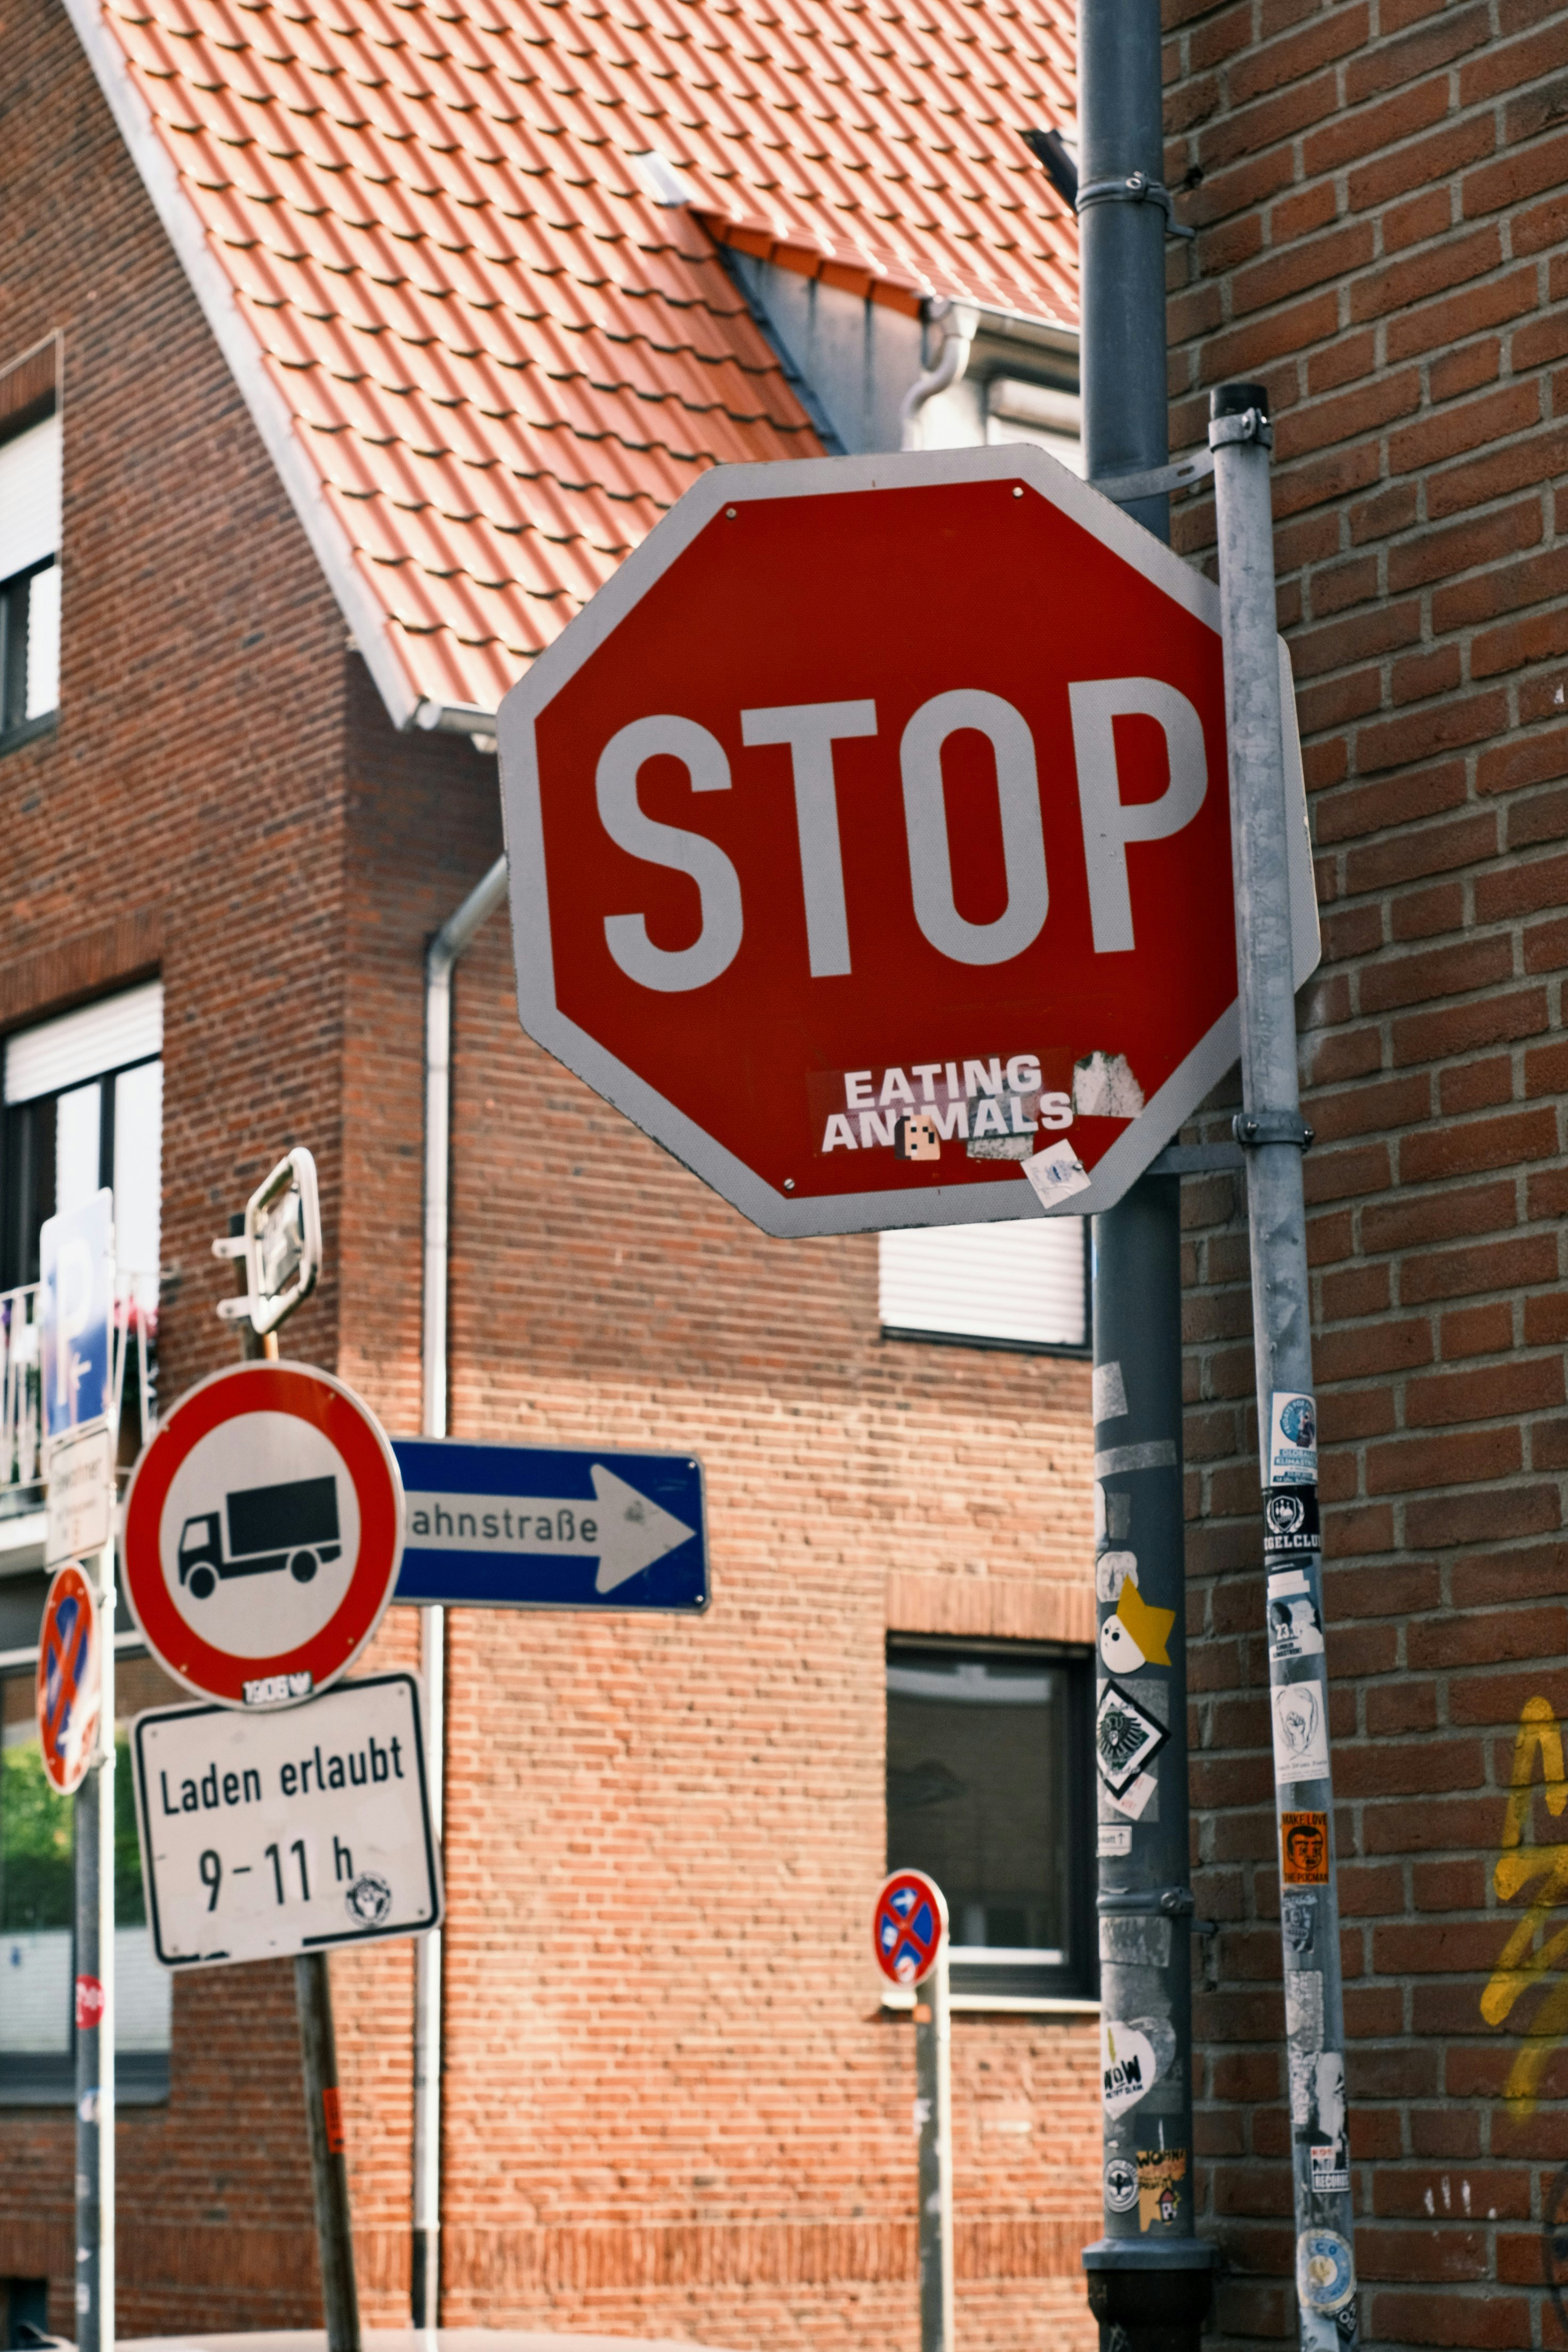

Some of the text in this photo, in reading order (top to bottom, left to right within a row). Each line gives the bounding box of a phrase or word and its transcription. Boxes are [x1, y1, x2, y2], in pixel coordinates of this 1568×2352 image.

[595, 677, 1208, 992] STOP
[845, 1055, 1042, 1109] EATING
[822, 1092, 1073, 1152] ANMALS
[412, 1502, 599, 1543] ahnstraße
[161, 1736, 405, 1816] Laden erlaubt
[333, 1835, 354, 1882] h
